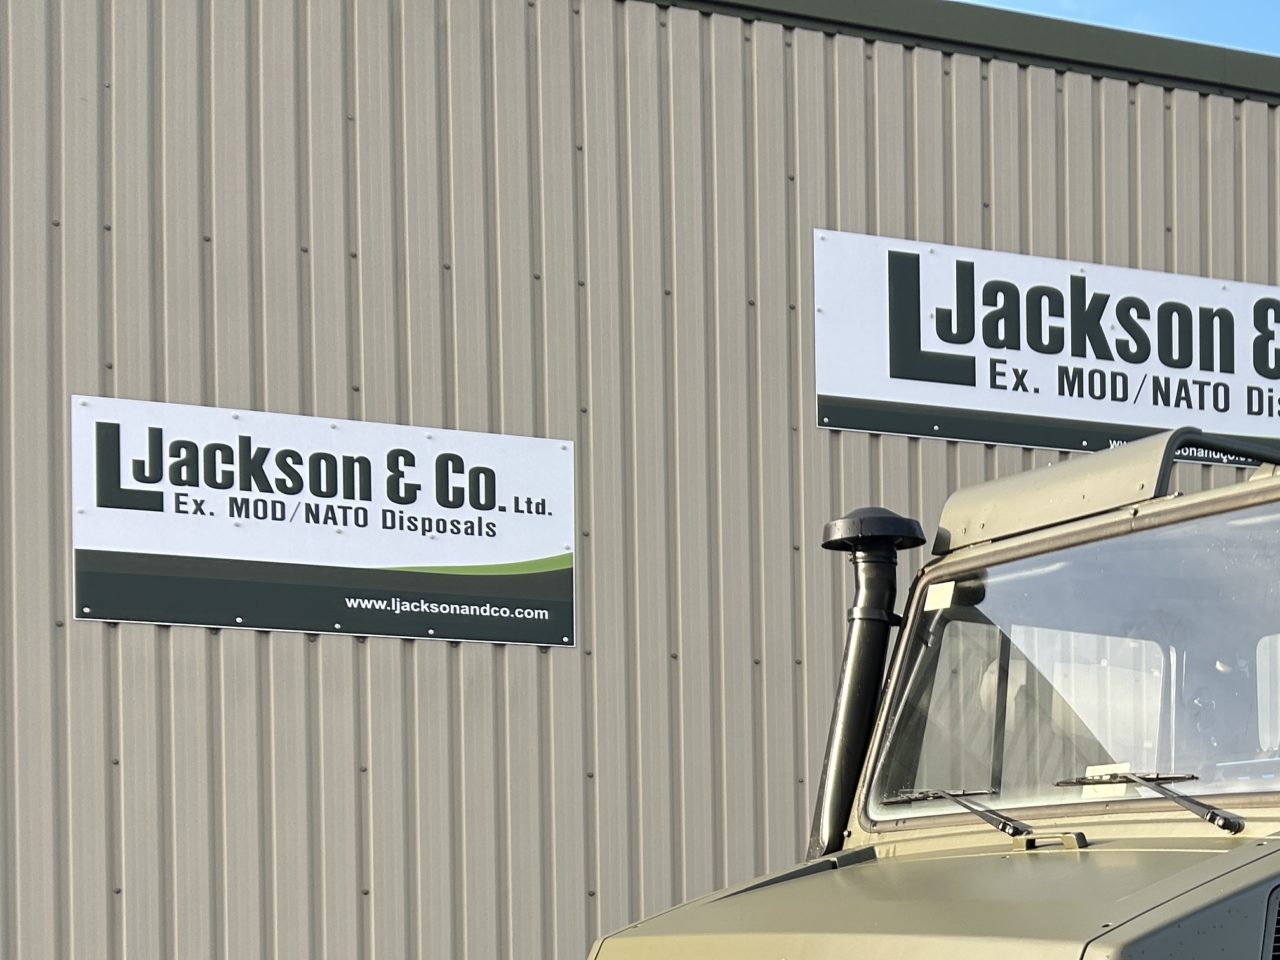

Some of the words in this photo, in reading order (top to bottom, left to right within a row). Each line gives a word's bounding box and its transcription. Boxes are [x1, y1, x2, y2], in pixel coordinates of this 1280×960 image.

[989, 357, 1040, 394] Ex.
[1057, 365, 1230, 413] MOD/NATO
[386, 448, 422, 506] &
[435, 452, 507, 512] Co.
[513, 496, 553, 517] Ltd.
[174, 492, 215, 517] Ex.
[228, 496, 369, 528] MOD/NATO
[381, 508, 498, 538] Disposals
[344, 597, 549, 620] www.ljacksonandco.com
